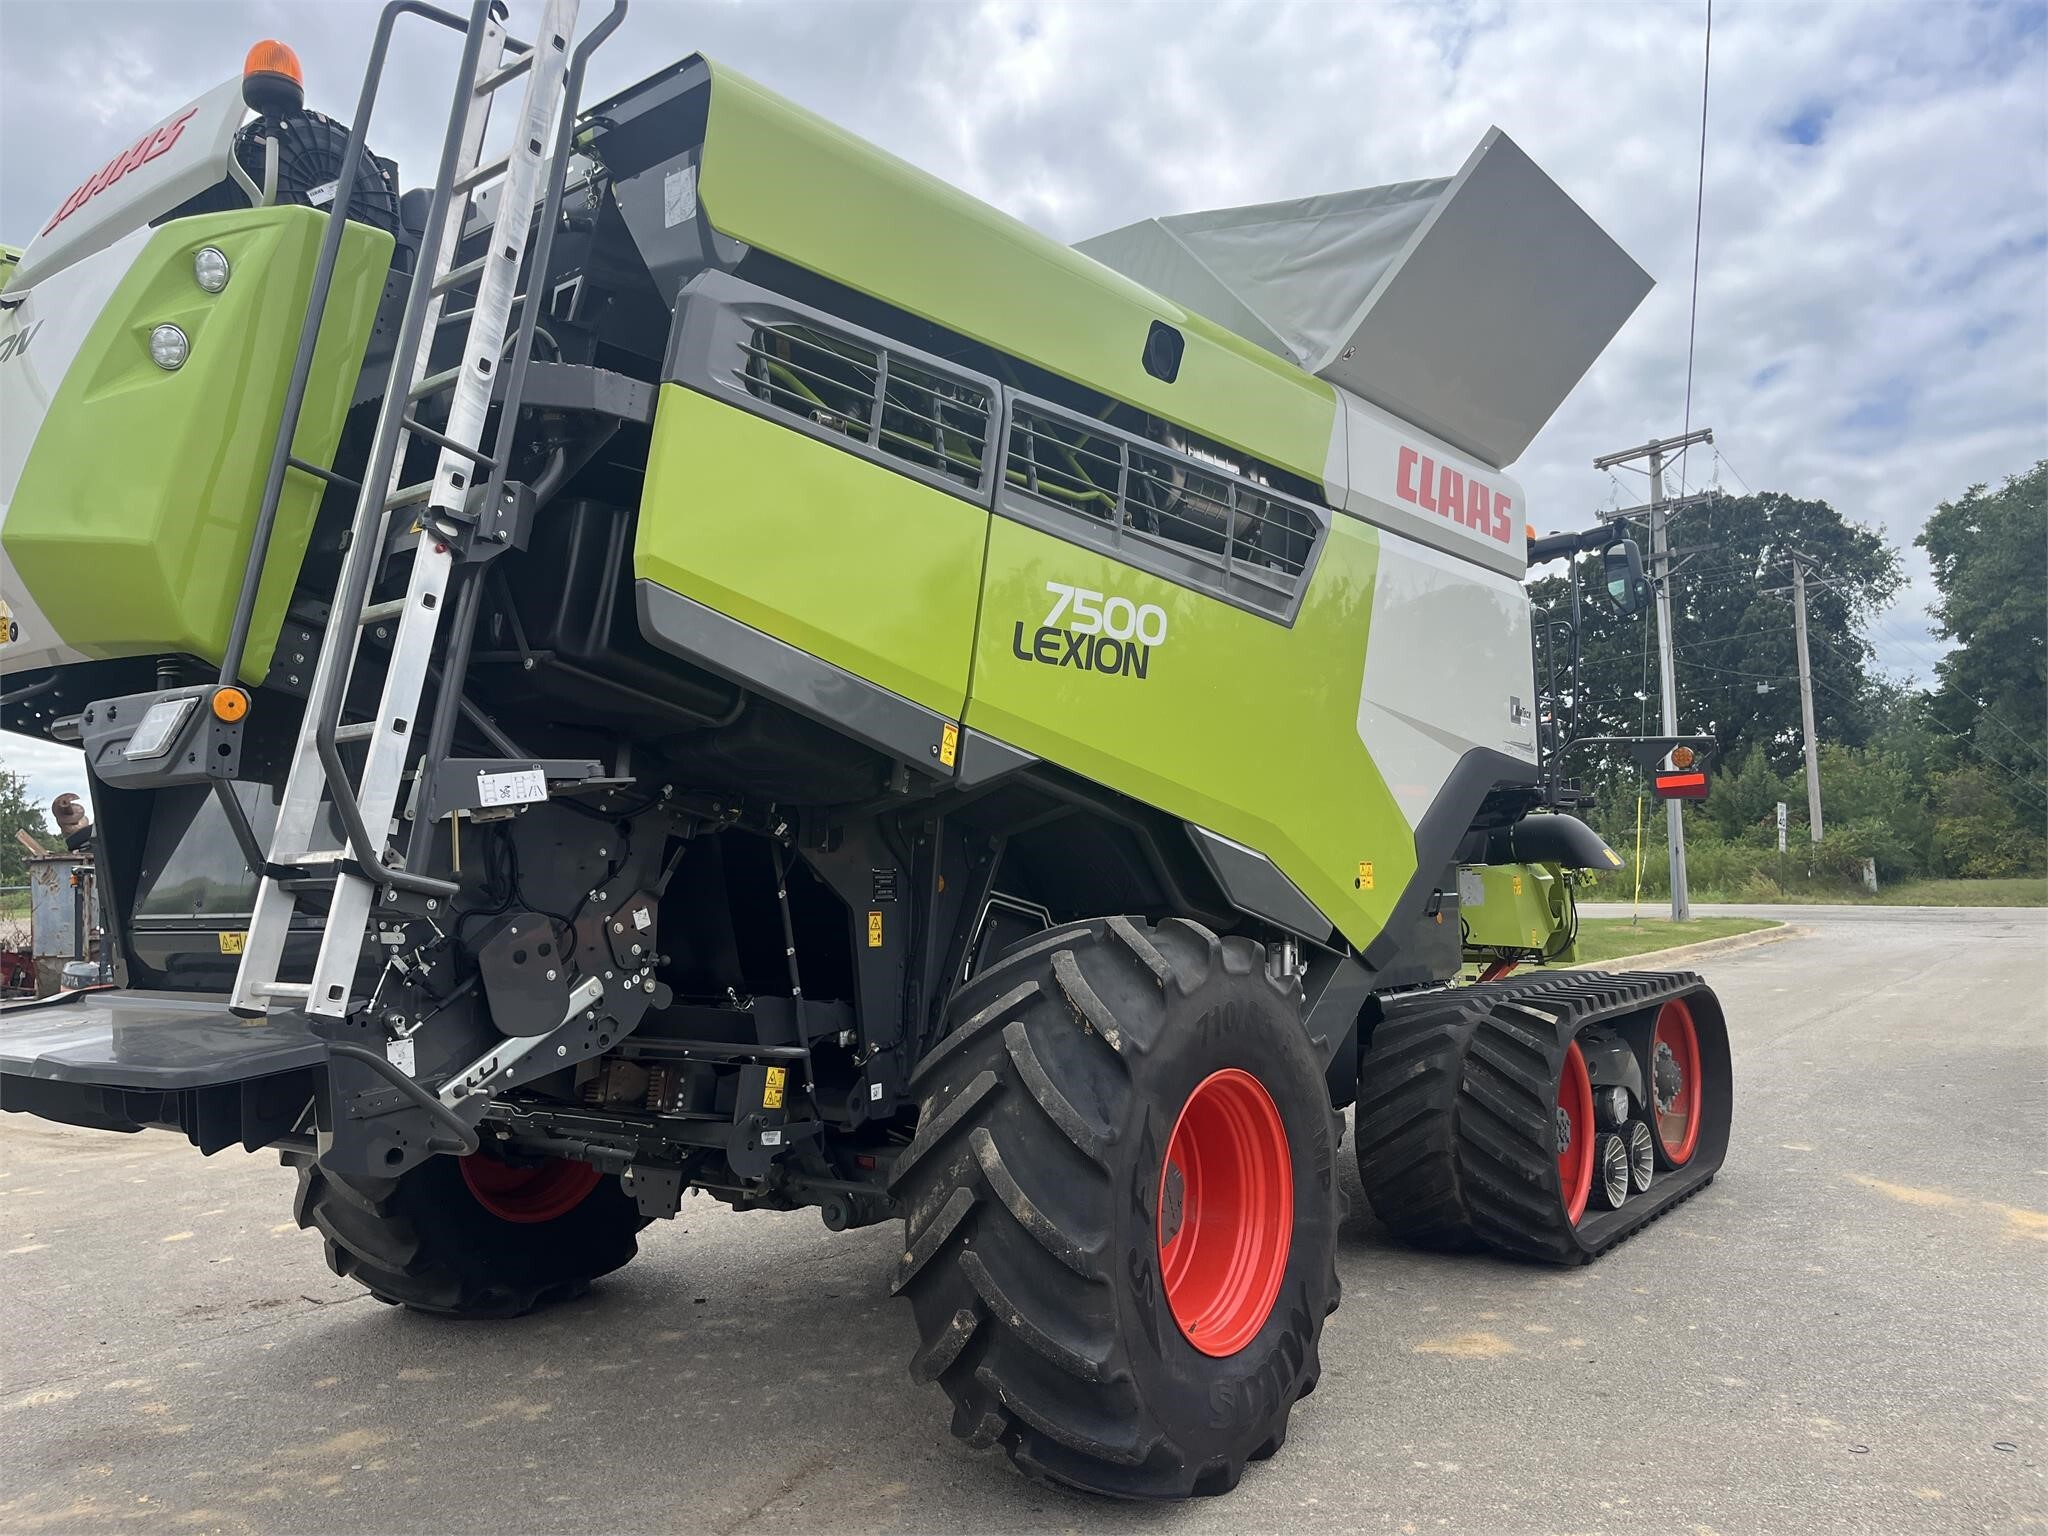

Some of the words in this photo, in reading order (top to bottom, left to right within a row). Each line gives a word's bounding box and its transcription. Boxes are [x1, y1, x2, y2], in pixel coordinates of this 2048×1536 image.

[41, 107, 199, 238] CLAAS
[1396, 445, 1512, 545] CLAAS
[1012, 621, 1150, 680] LEXION
[1042, 581, 1168, 647] 7500
